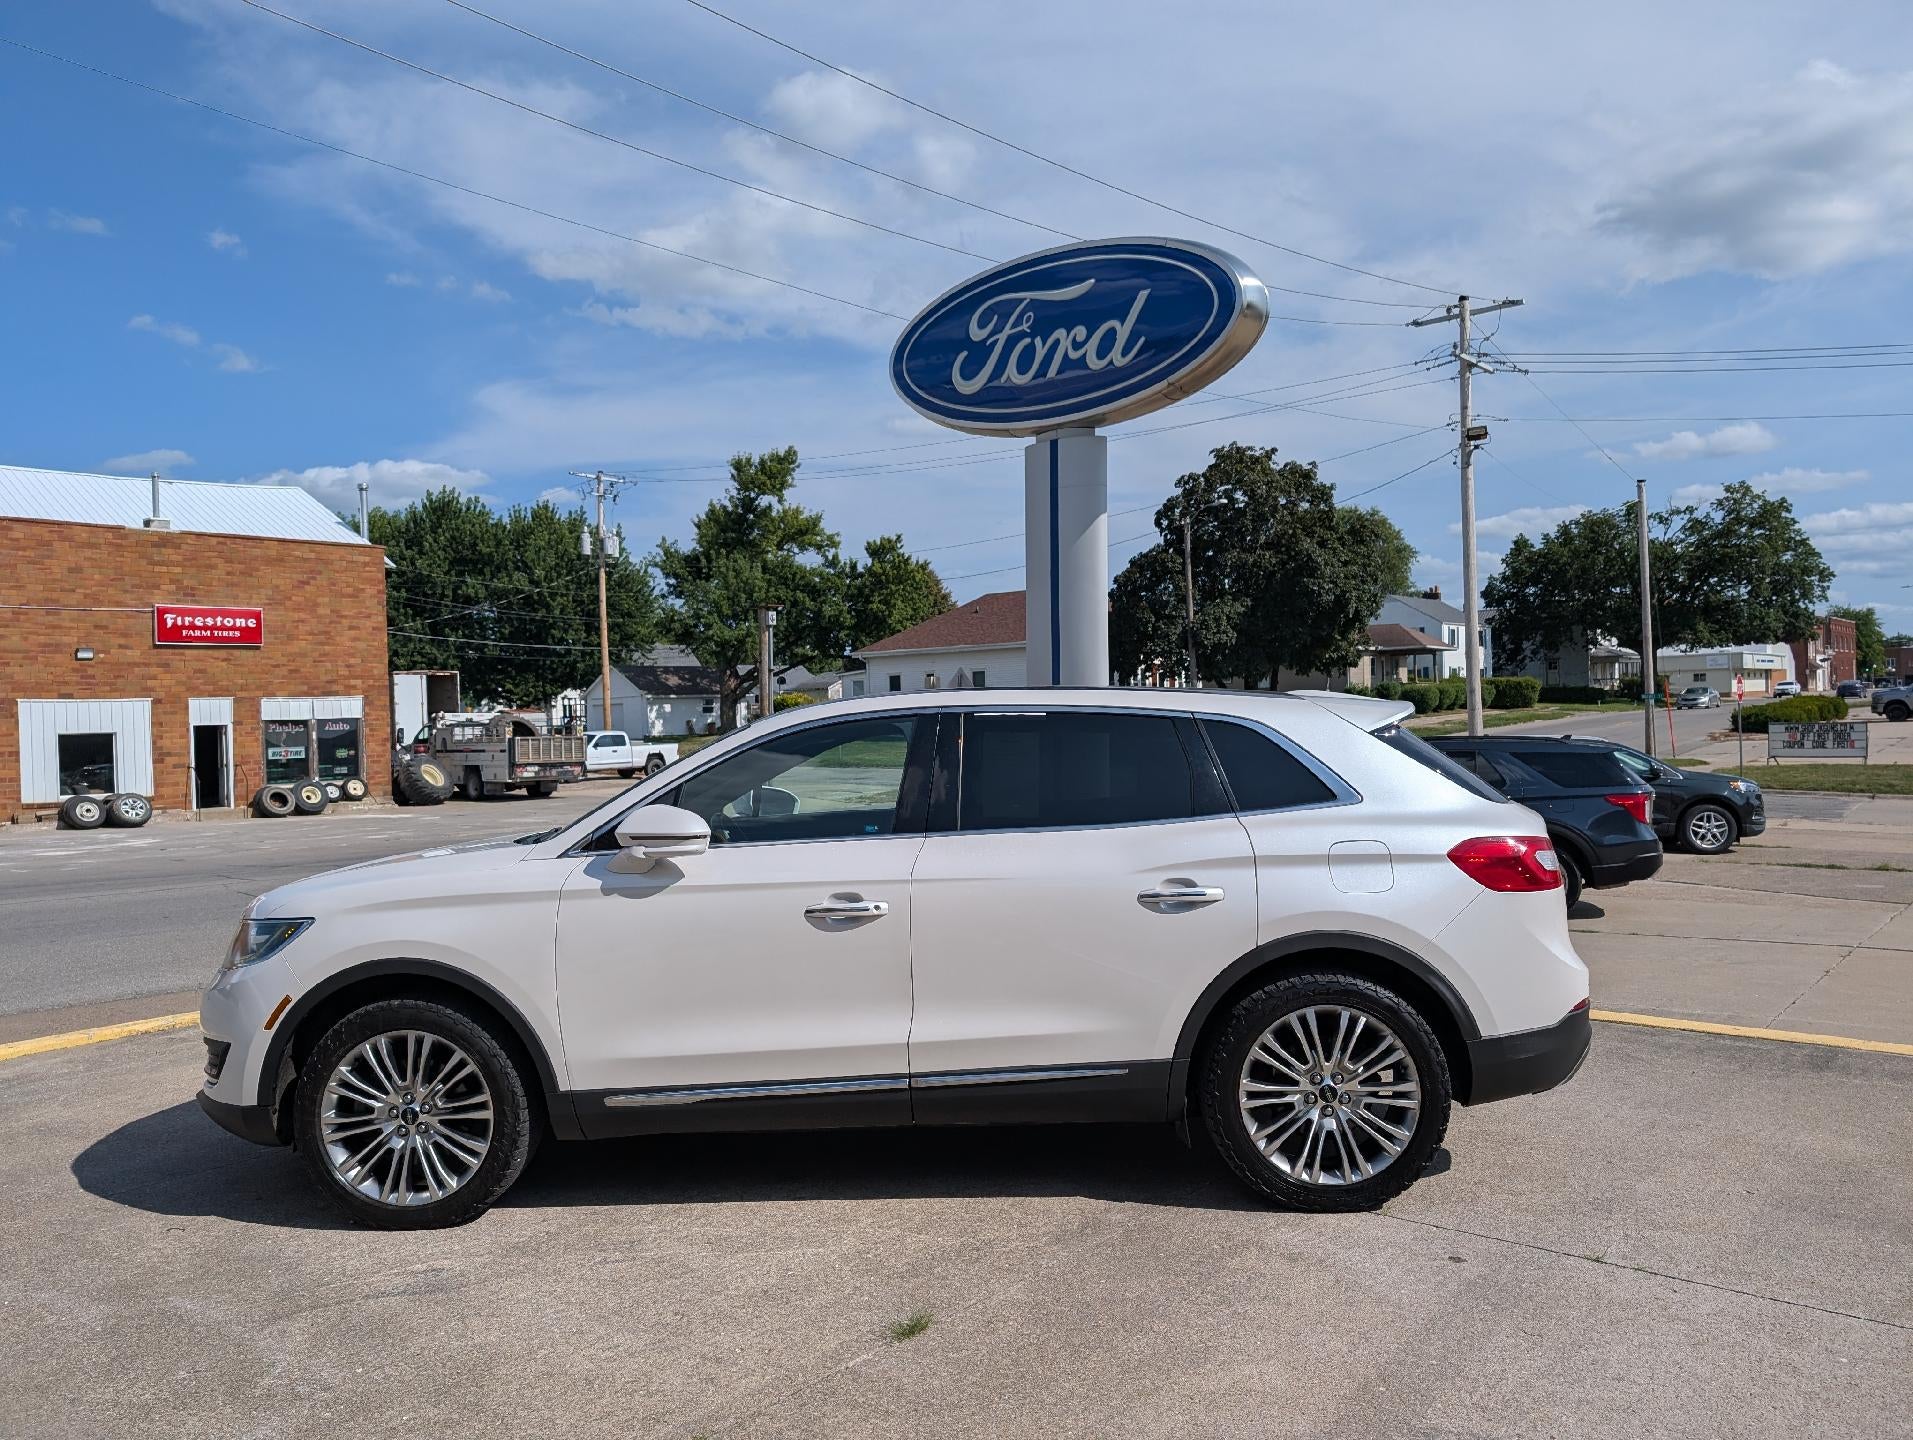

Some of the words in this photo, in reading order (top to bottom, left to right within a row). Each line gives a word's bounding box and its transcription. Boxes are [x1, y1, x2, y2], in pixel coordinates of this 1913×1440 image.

[952, 278, 1151, 395] Ford
[163, 613, 257, 629] Firestone
[182, 629, 211, 637] FARM
[213, 630, 241, 638] TIRES
[324, 721, 350, 731] Auto
[1832, 732, 1851, 741] ORDER
[1782, 740, 1805, 749] COUPON
[1811, 740, 1827, 749] CODE
